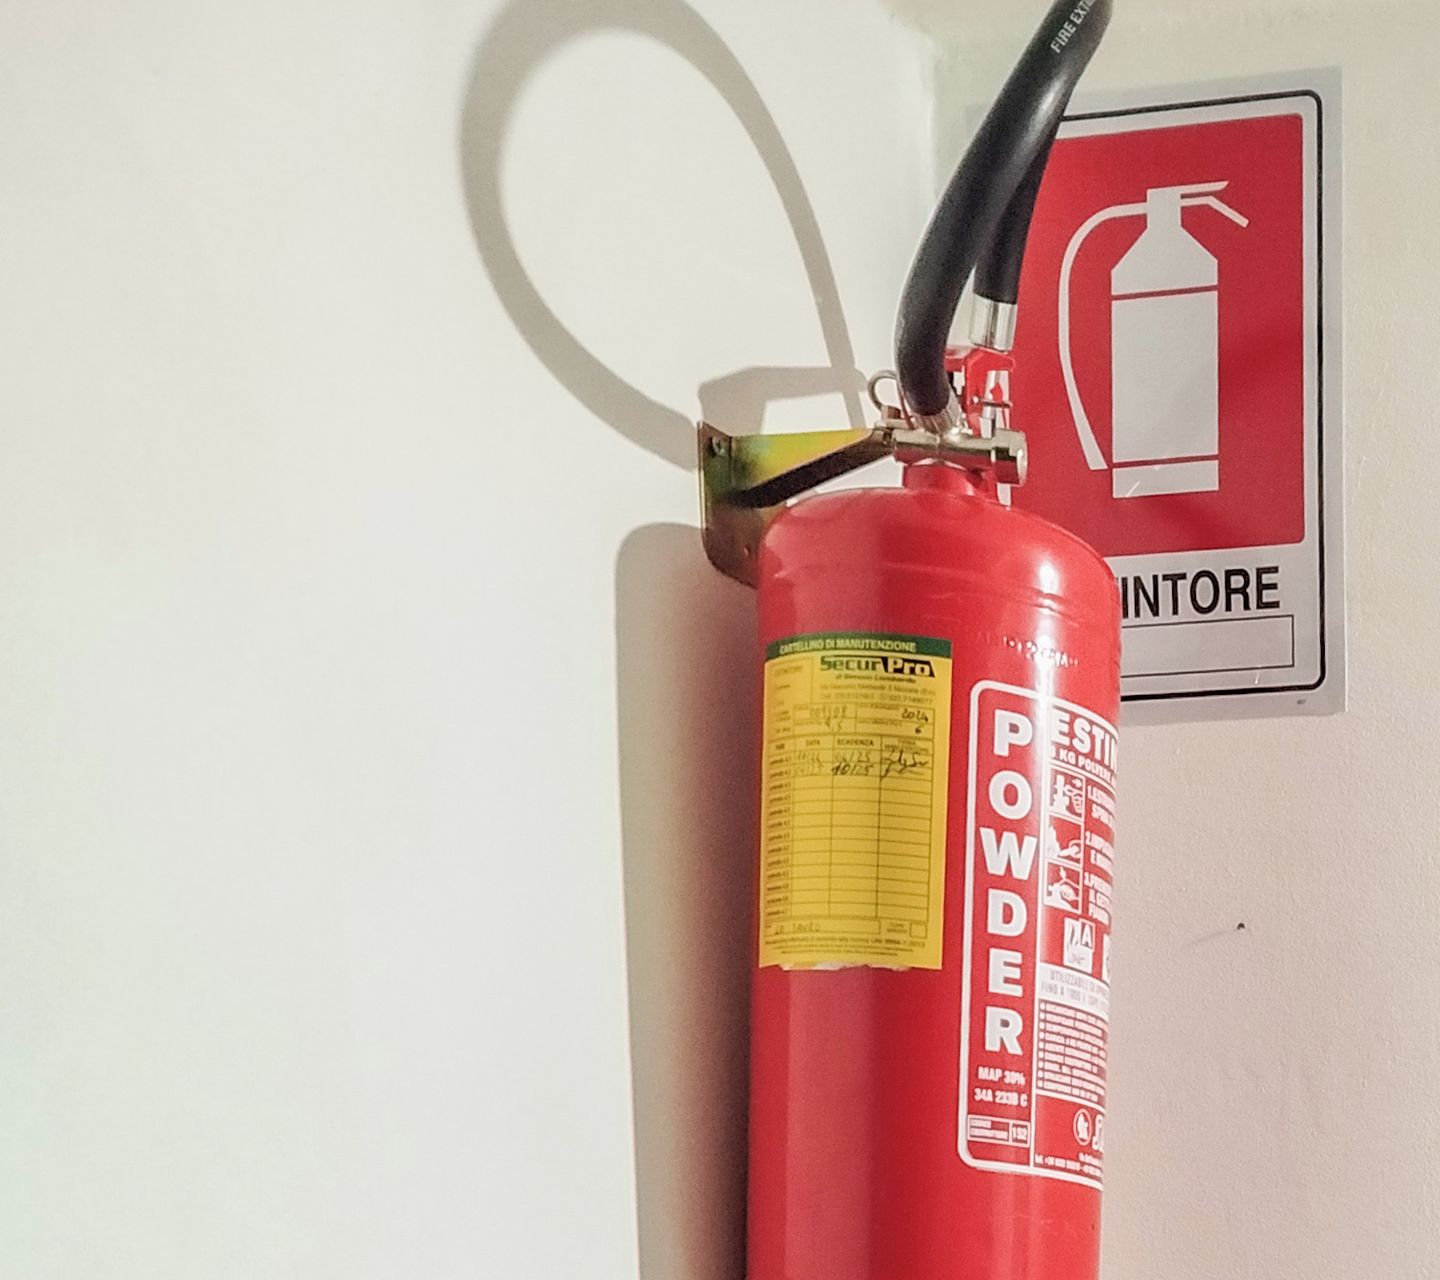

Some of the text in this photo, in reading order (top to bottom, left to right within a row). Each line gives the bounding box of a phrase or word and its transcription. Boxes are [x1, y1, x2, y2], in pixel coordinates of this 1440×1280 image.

[1050, 21, 1076, 54] FIRE
[1117, 565, 1281, 619] INTORE
[826, 640, 835, 650] DI
[836, 639, 917, 653] MANUTENZIONE
[979, 708, 1038, 1057] POWDER
[978, 1066, 1026, 1086] MAP 30%
[974, 1087, 993, 1102] 34A
[1020, 1093, 1028, 1108] C
